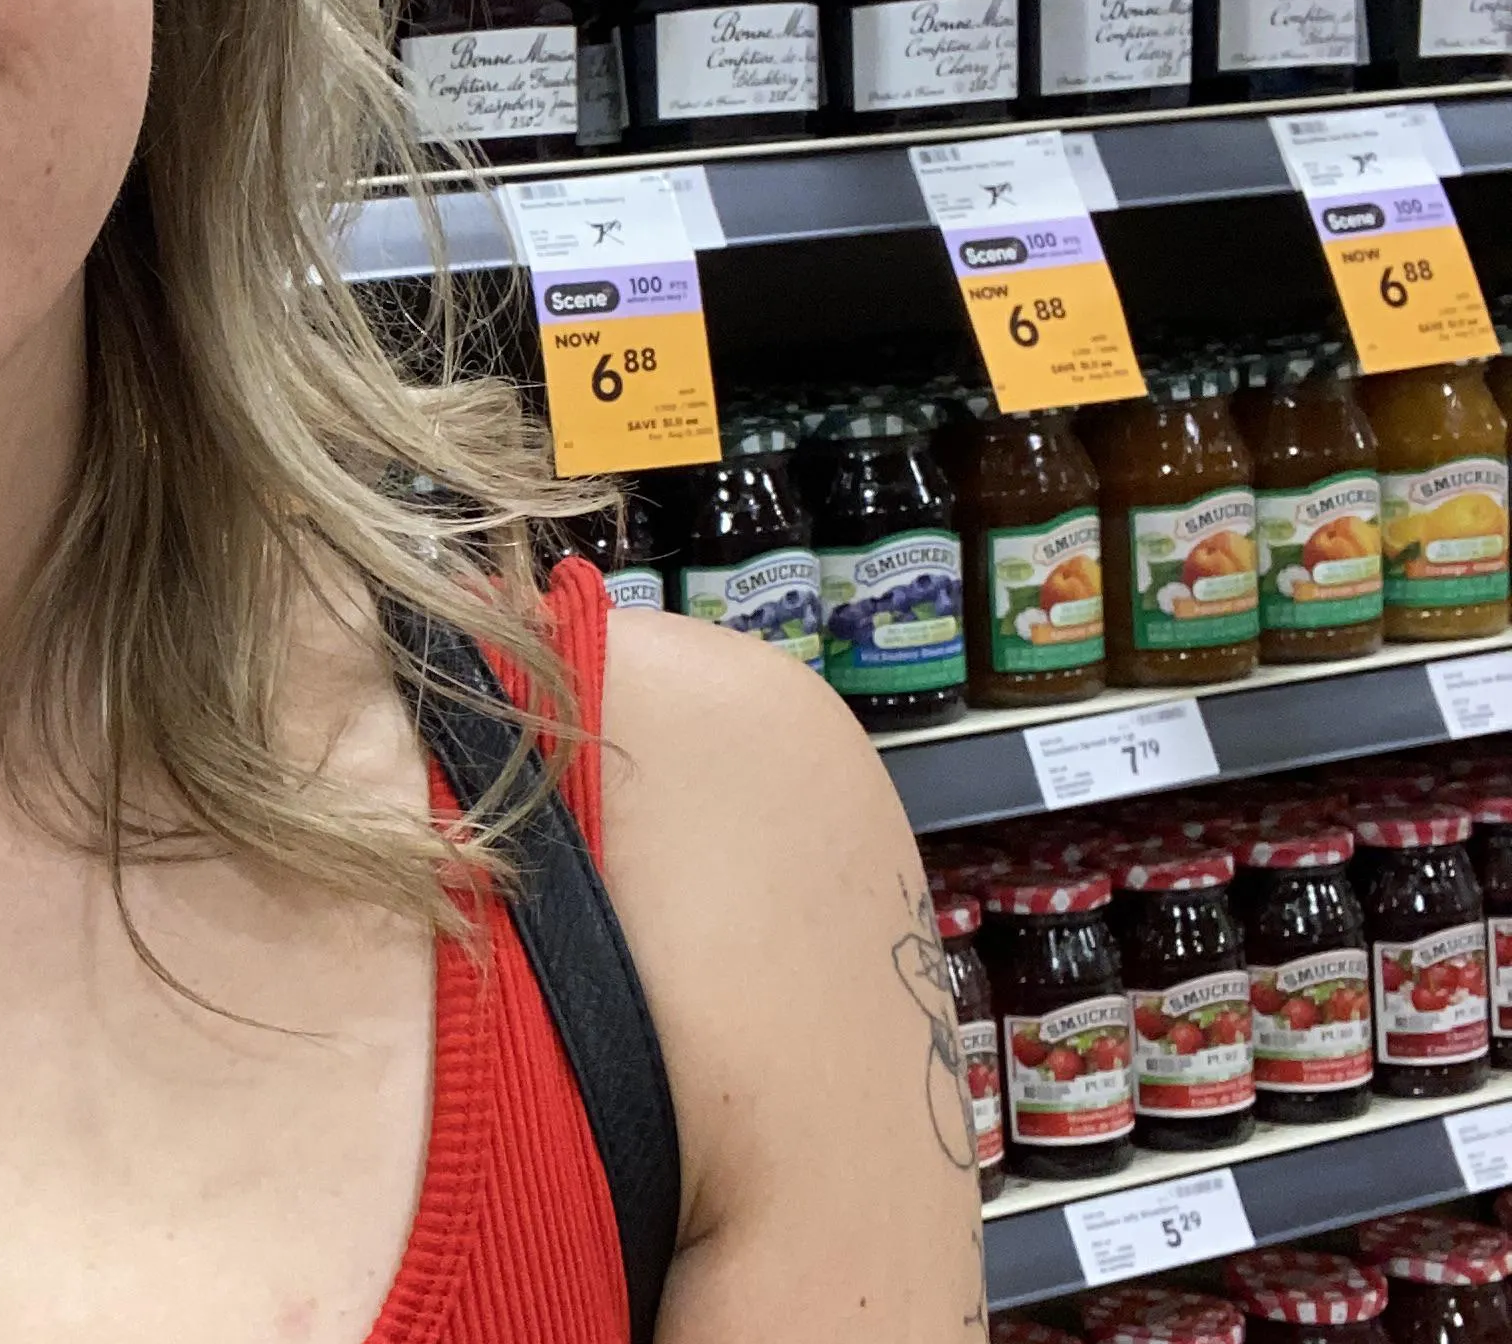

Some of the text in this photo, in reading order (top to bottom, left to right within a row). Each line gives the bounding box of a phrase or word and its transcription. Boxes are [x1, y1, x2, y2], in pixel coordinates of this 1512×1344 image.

[450, 36, 518, 70] Bonne
[1027, 233, 1056, 249] 100
[1341, 248, 1380, 263] NOW
[629, 276, 662, 295] 100
[969, 284, 1008, 300] NOW
[555, 331, 600, 348] NOW
